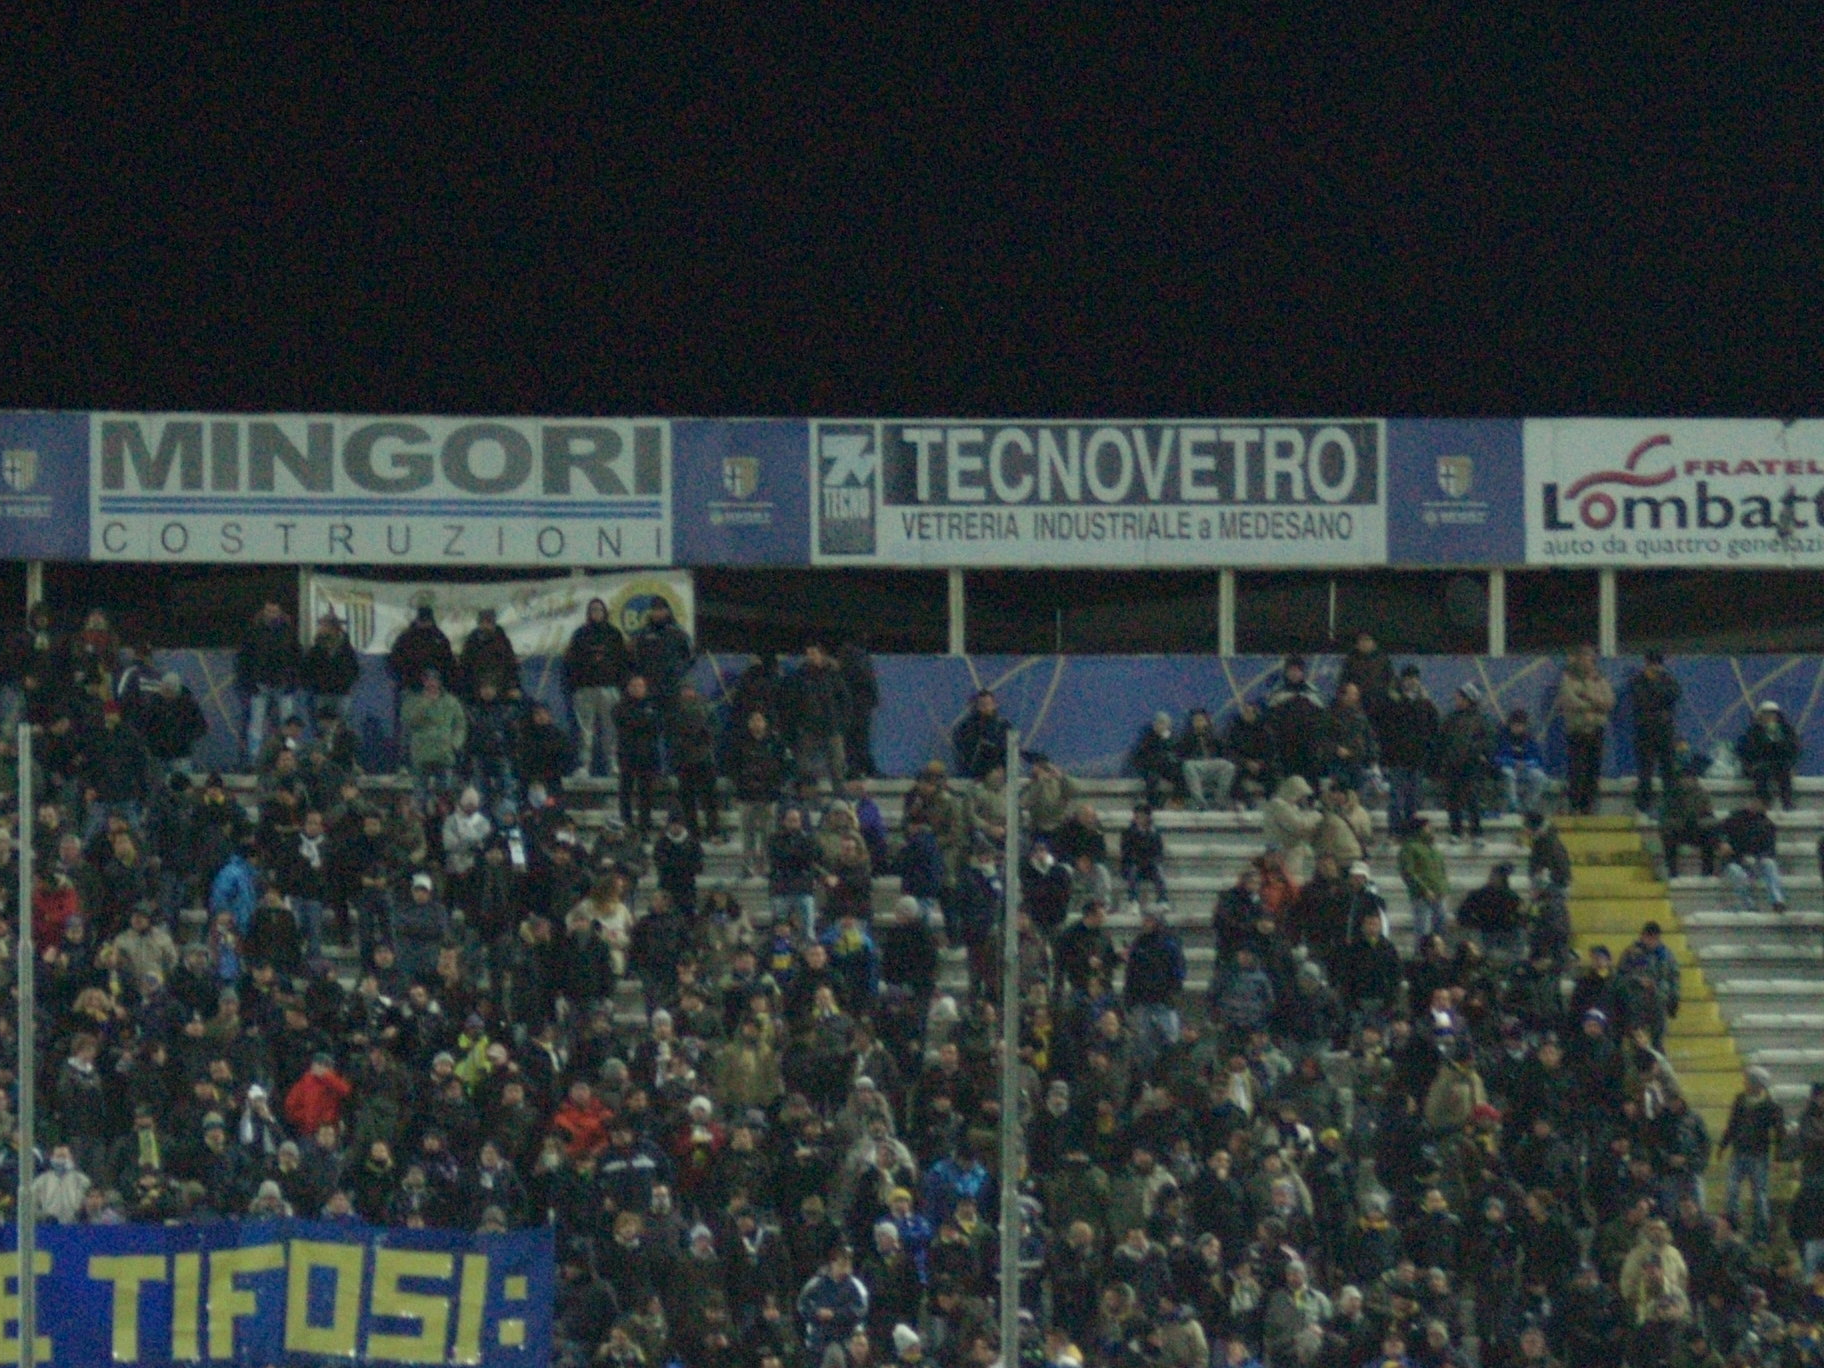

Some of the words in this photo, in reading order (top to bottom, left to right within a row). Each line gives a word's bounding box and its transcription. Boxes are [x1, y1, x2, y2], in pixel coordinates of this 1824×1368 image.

[100, 420, 664, 495] MINGORI
[903, 427, 1358, 503] TECNOVETRO
[102, 522, 664, 559] COSTRUZIONI
[902, 511, 1019, 540] VETRERIA
[1033, 511, 1191, 541] INDUSTRIALE
[1219, 511, 1353, 541] MEDESANO
[87, 1238, 527, 1365] TIFOSI:
